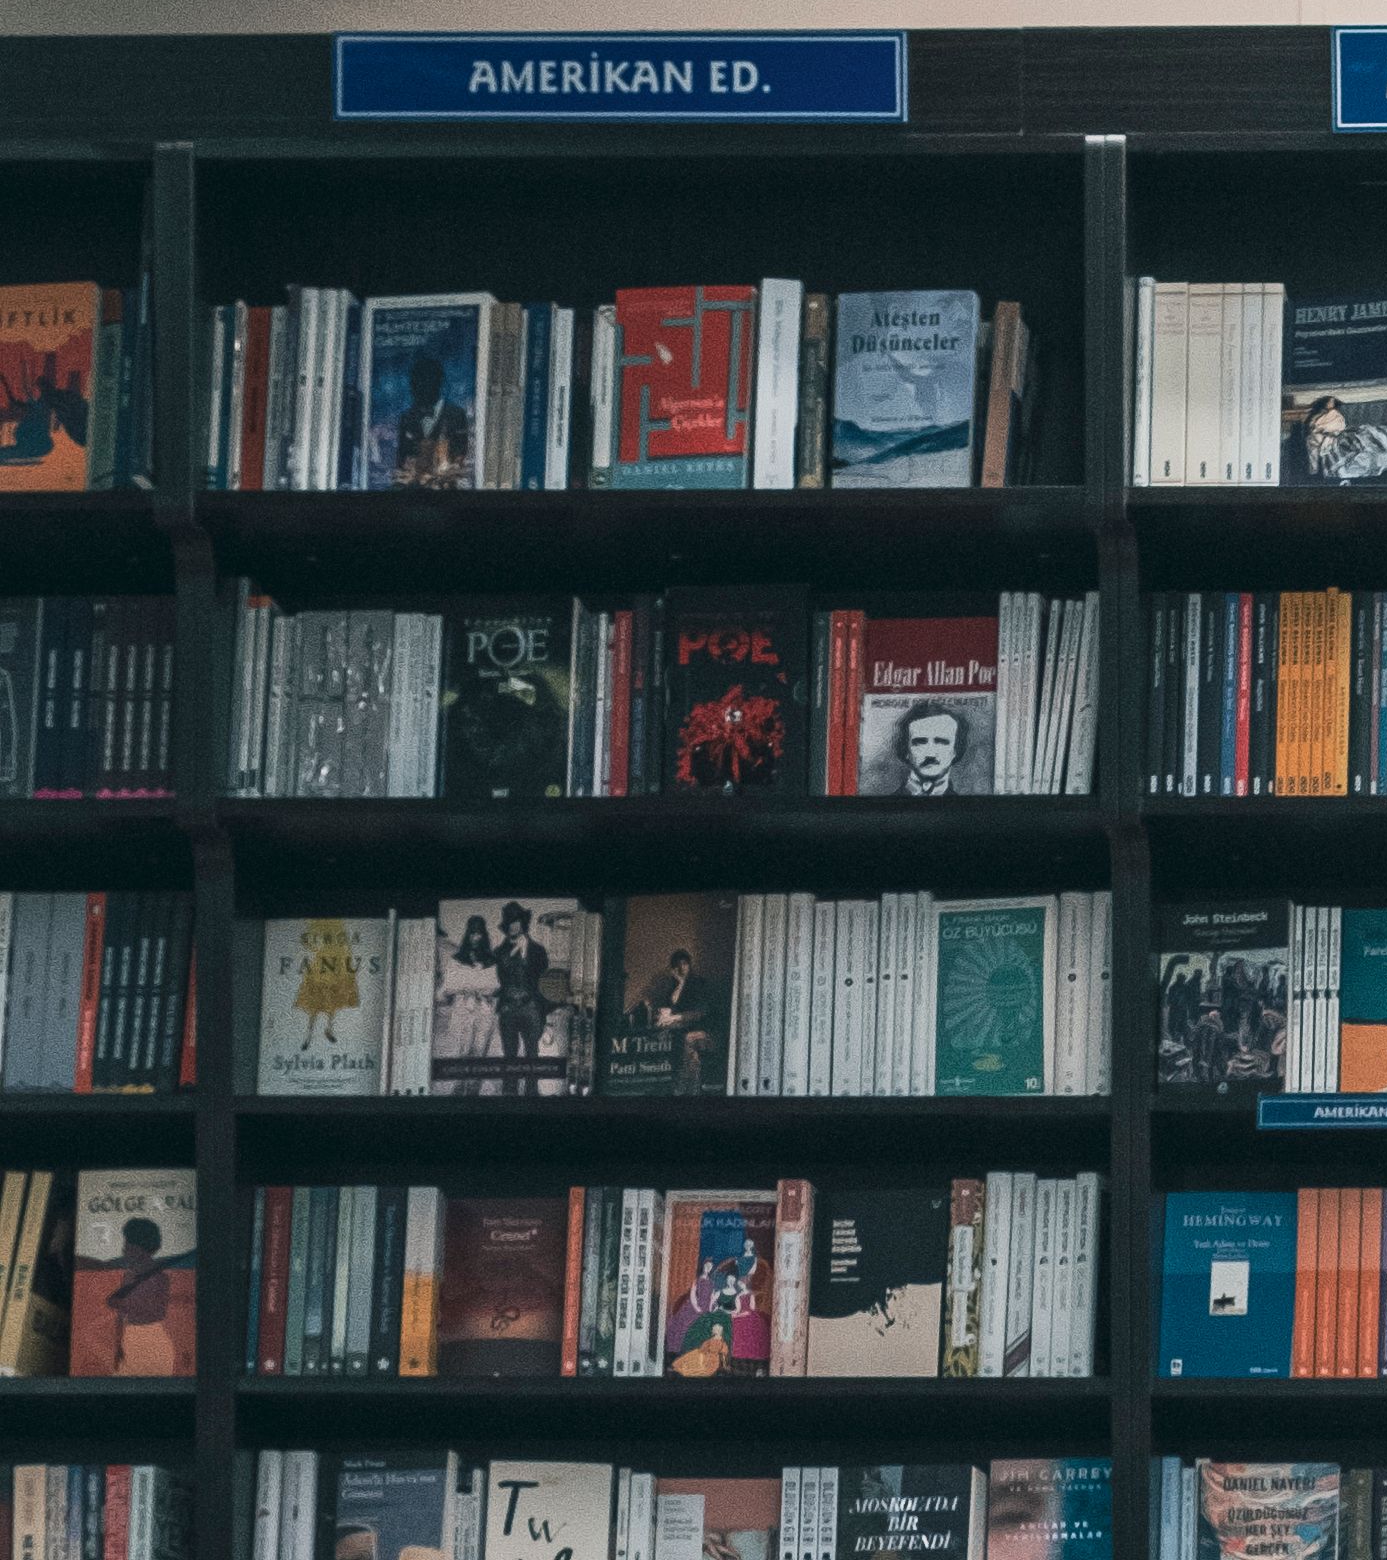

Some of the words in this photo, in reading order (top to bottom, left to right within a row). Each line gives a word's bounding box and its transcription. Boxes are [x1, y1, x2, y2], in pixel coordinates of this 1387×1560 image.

[469, 52, 694, 93] AMERİKAN
[708, 61, 772, 93] ED.
[870, 308, 941, 331] Ateşten
[1295, 304, 1349, 325] HENRY
[851, 332, 959, 357] Düşünceler
[466, 627, 551, 667] POE
[678, 629, 780, 666] POE
[872, 660, 919, 689] Edgar
[921, 660, 966, 687] Allan
[967, 660, 997, 687] Poe
[1183, 914, 1209, 926] John
[1212, 912, 1268, 925] Steinbeck
[278, 956, 382, 976] FANUS
[610, 1037, 629, 1054] M
[273, 1053, 324, 1075] Sylvia
[331, 1054, 375, 1071] Plath
[1183, 1214, 1283, 1228] HEMINGWAY
[1223, 1478, 1268, 1492] DANIEL
[887, 1513, 919, 1533] BİR
[854, 1533, 954, 1552] BEYEFENDİ
